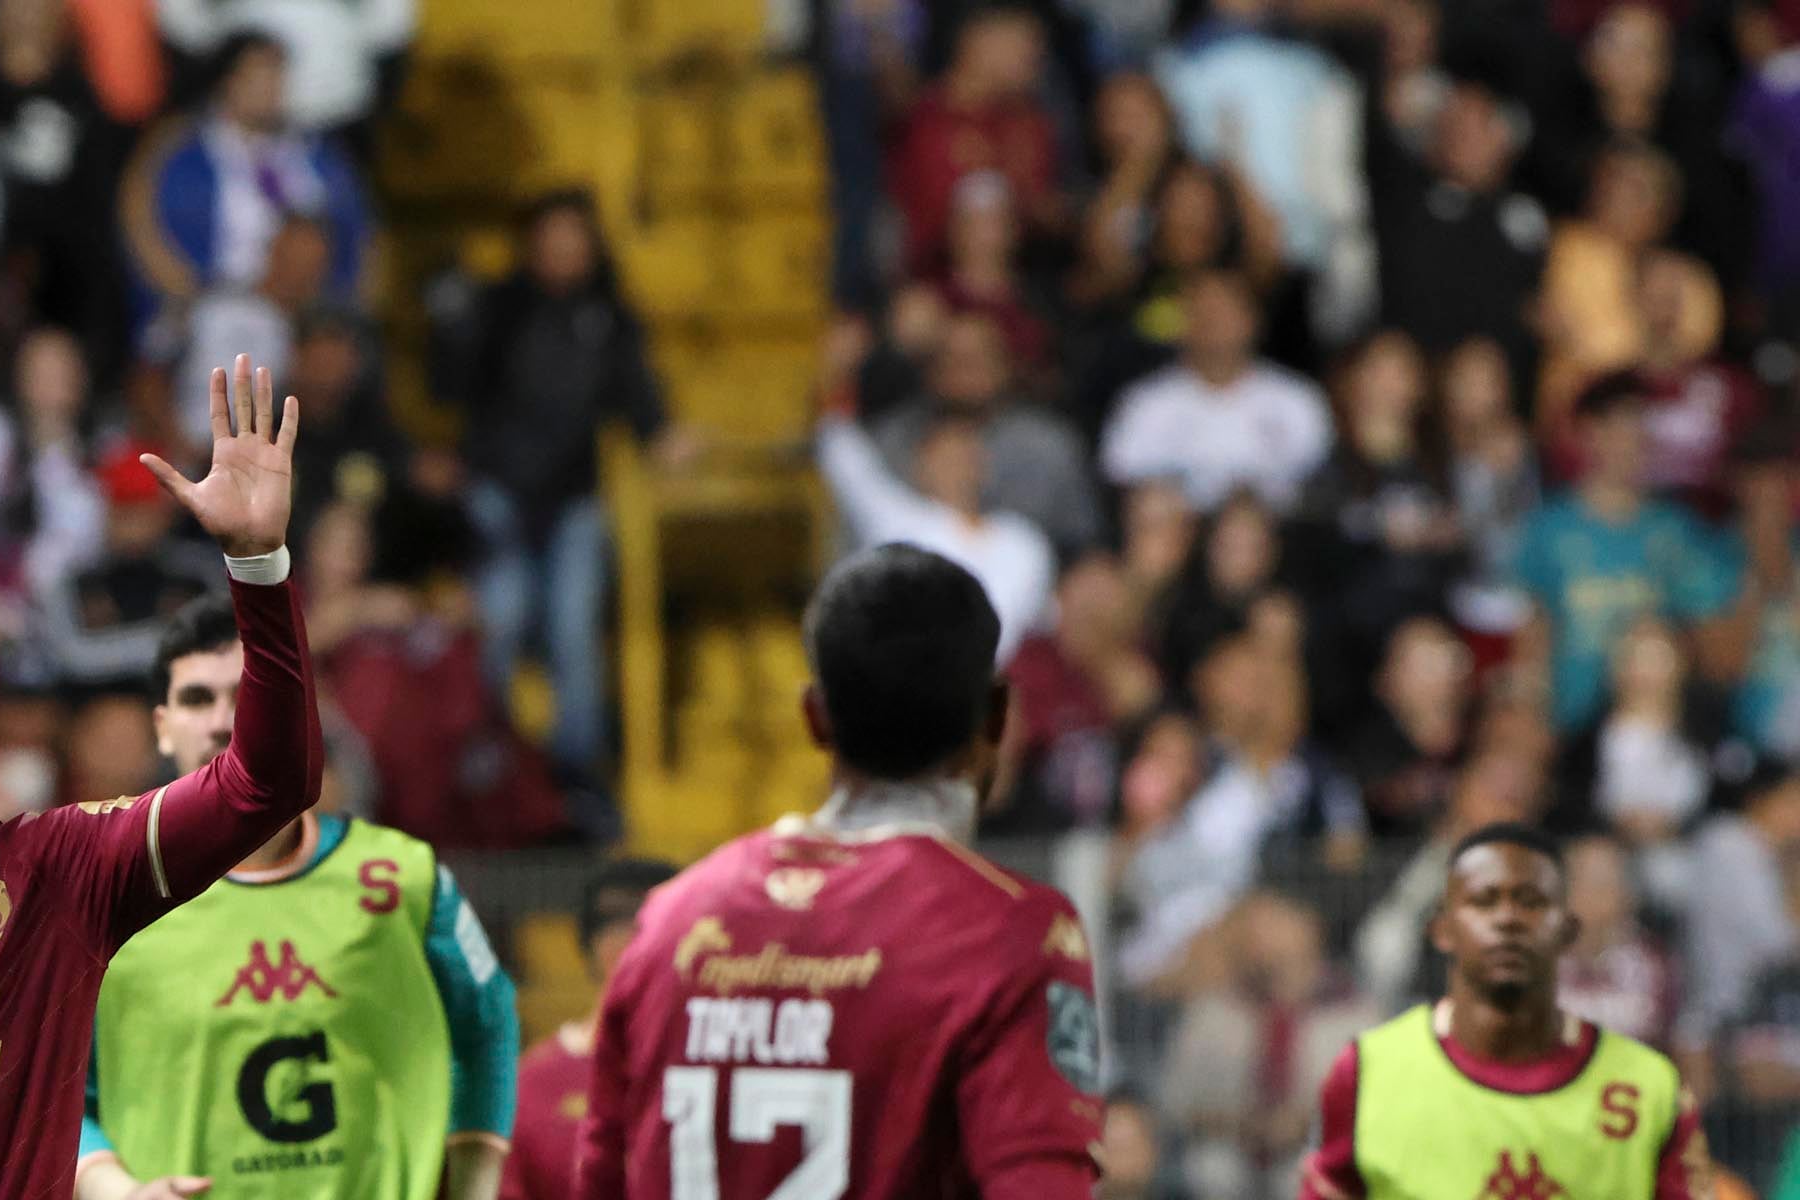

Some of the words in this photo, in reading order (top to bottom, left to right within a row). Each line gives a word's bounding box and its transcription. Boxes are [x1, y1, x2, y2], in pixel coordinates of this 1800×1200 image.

[358, 858, 403, 915] S
[685, 995, 834, 1065] TAYLOR
[236, 1029, 337, 1144] G
[1599, 1081, 1641, 1140] S
